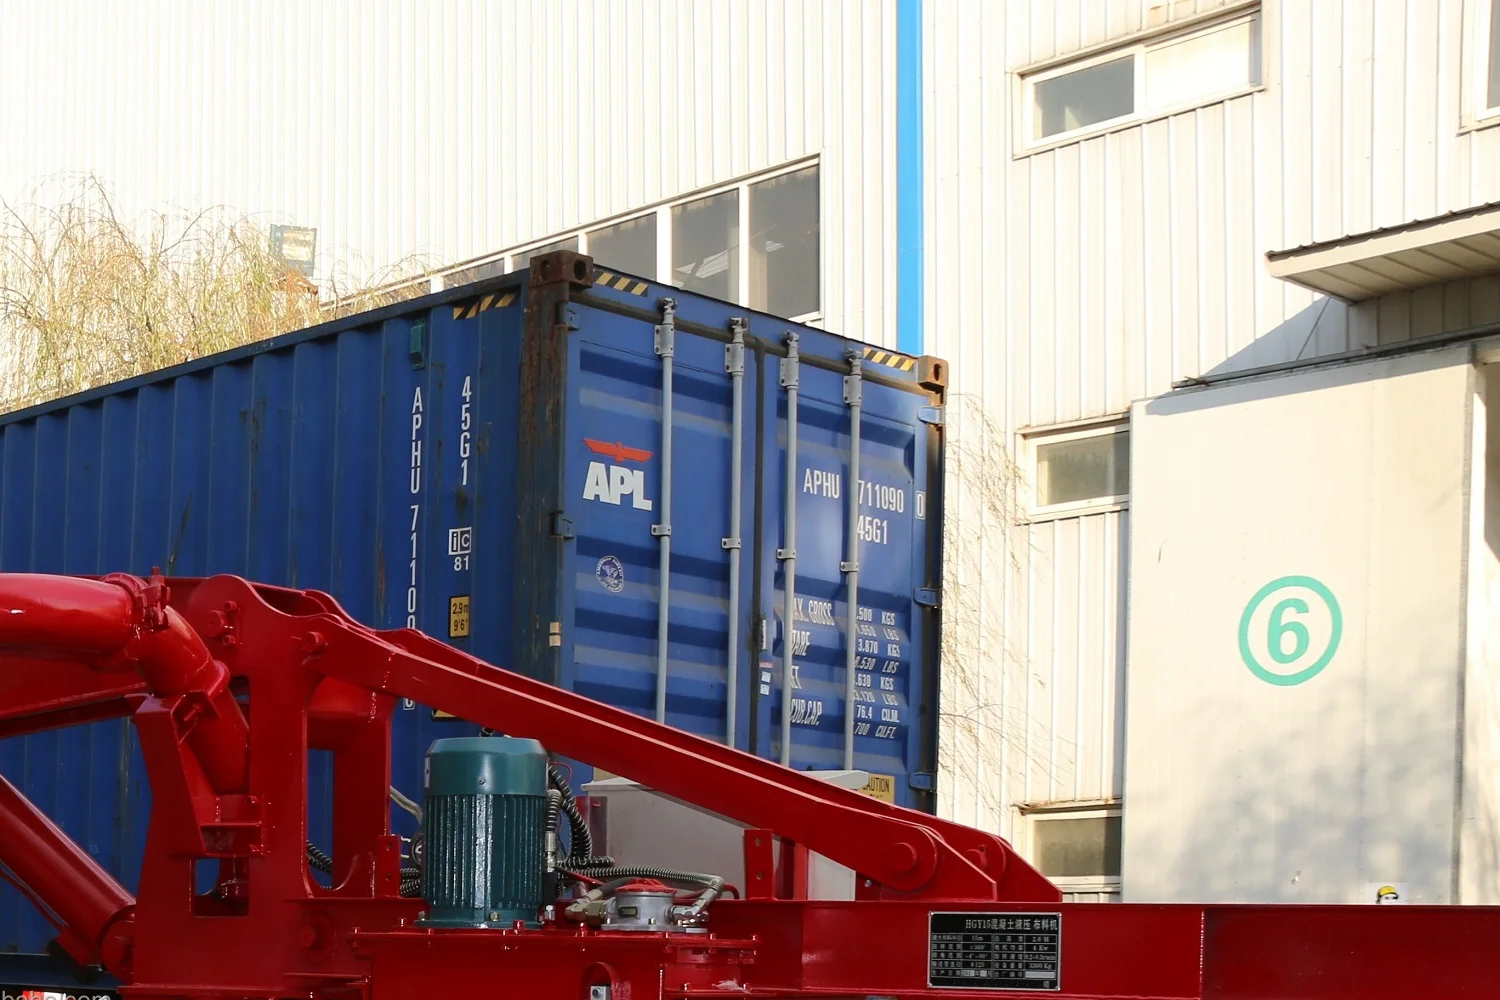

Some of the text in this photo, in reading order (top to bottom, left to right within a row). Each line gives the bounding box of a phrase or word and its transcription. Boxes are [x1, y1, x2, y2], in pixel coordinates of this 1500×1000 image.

[411, 386, 423, 494] APHU
[583, 461, 652, 511] APL
[803, 468, 840, 499] APHU
[858, 480, 904, 513] 711090
[857, 515, 888, 545] 45G1
[454, 556, 469, 571] 81
[793, 598, 835, 626] AX. GROSS
[856, 607, 895, 626] .500 KGS
[883, 628, 899, 641] LBS
[1267, 597, 1310, 664] 6
[888, 643, 900, 657] KGS
[791, 665, 802, 689] ET
[882, 660, 899, 673] LBS
[855, 673, 893, 690] .630 KGS
[882, 693, 898, 706] LBS
